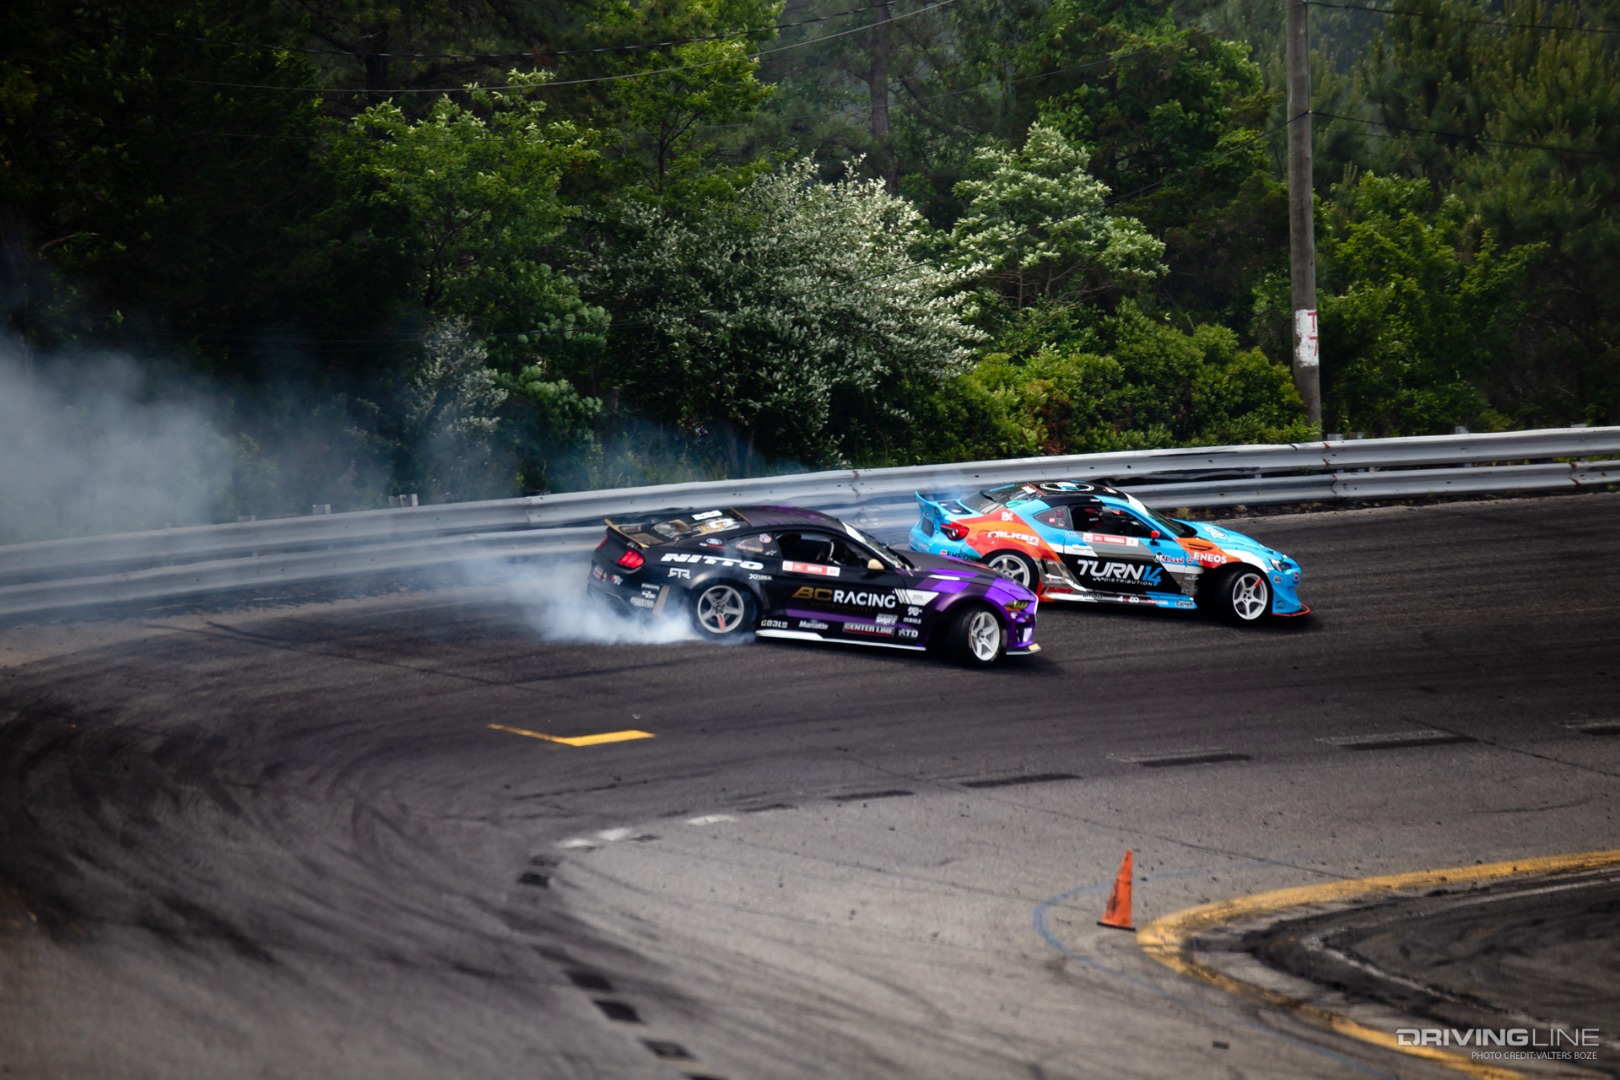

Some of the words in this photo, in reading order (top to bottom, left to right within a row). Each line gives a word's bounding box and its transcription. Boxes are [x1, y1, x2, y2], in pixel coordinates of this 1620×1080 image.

[660, 553, 764, 570] NITTO
[1194, 551, 1228, 565] ENEOS
[1104, 577, 1153, 587] DISTRIBUTION
